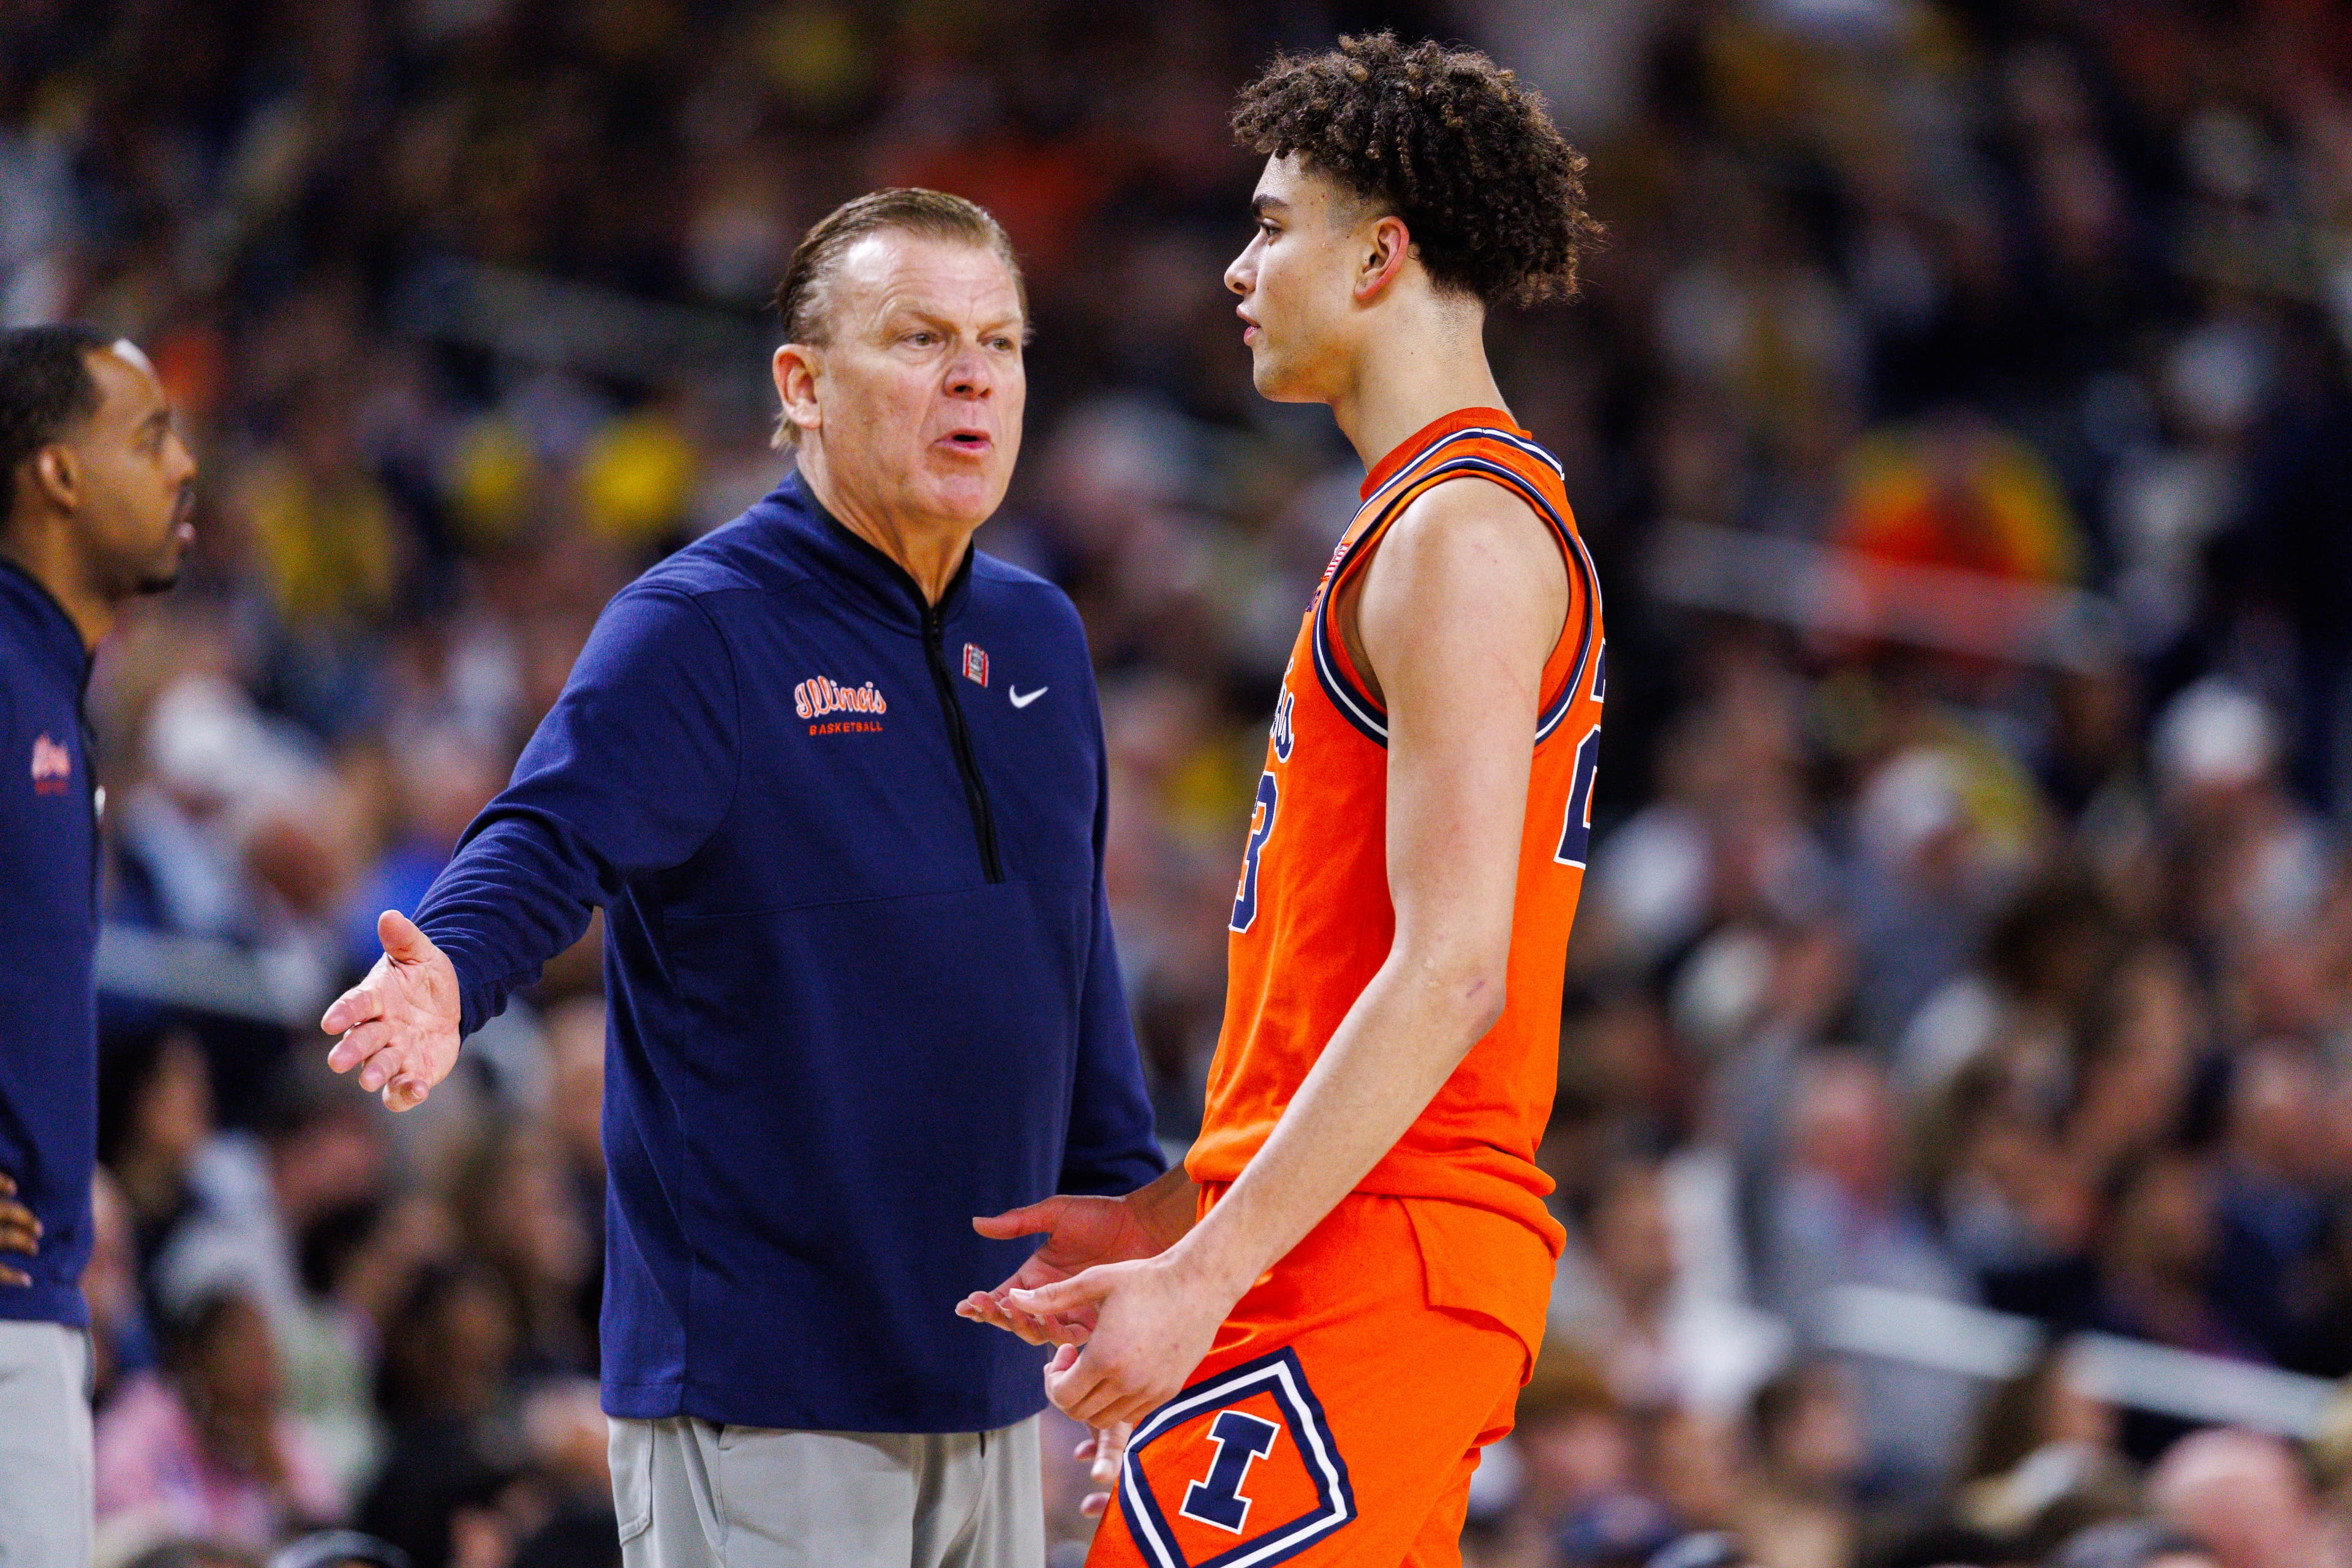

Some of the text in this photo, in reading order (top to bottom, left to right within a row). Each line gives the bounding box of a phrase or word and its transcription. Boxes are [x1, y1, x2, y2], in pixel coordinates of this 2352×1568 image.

[794, 676, 887, 719] Illinois
[809, 721, 883, 736] BASKETBALL
[1179, 1410, 1281, 1535] I
